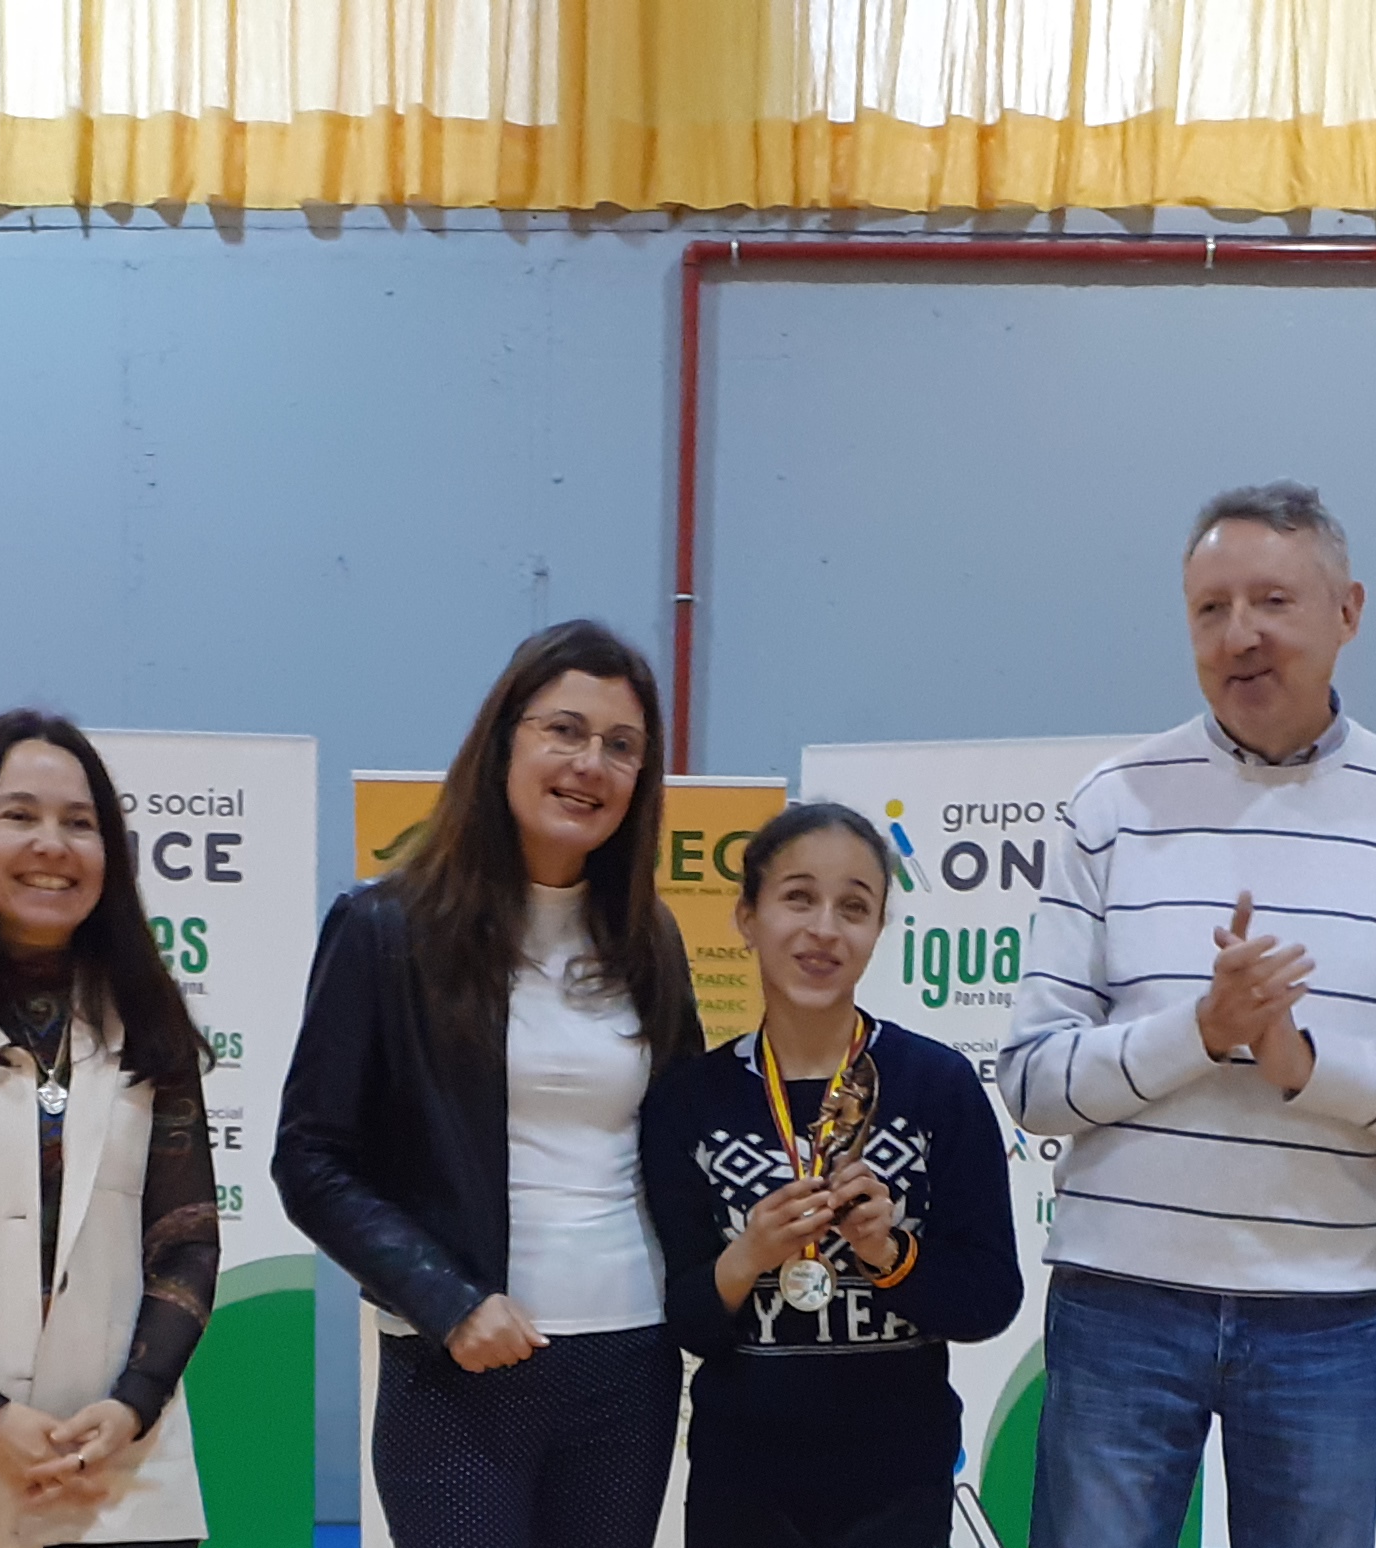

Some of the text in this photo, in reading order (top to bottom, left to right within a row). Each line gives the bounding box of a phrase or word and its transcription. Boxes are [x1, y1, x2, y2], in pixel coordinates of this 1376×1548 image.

[147, 788, 243, 817] social
[942, 801, 1045, 832] grupo
[126, 830, 243, 883] CE
[670, 830, 758, 882] EC
[941, 839, 1045, 892] ON
[148, 916, 209, 974] es
[903, 915, 1034, 1008] igua
[952, 1039, 998, 1053] social
[979, 1059, 996, 1083] E
[206, 1107, 243, 1120] ocial
[207, 1126, 243, 1150] CE
[1040, 1138, 1062, 1161] O
[216, 1184, 243, 1212] es
